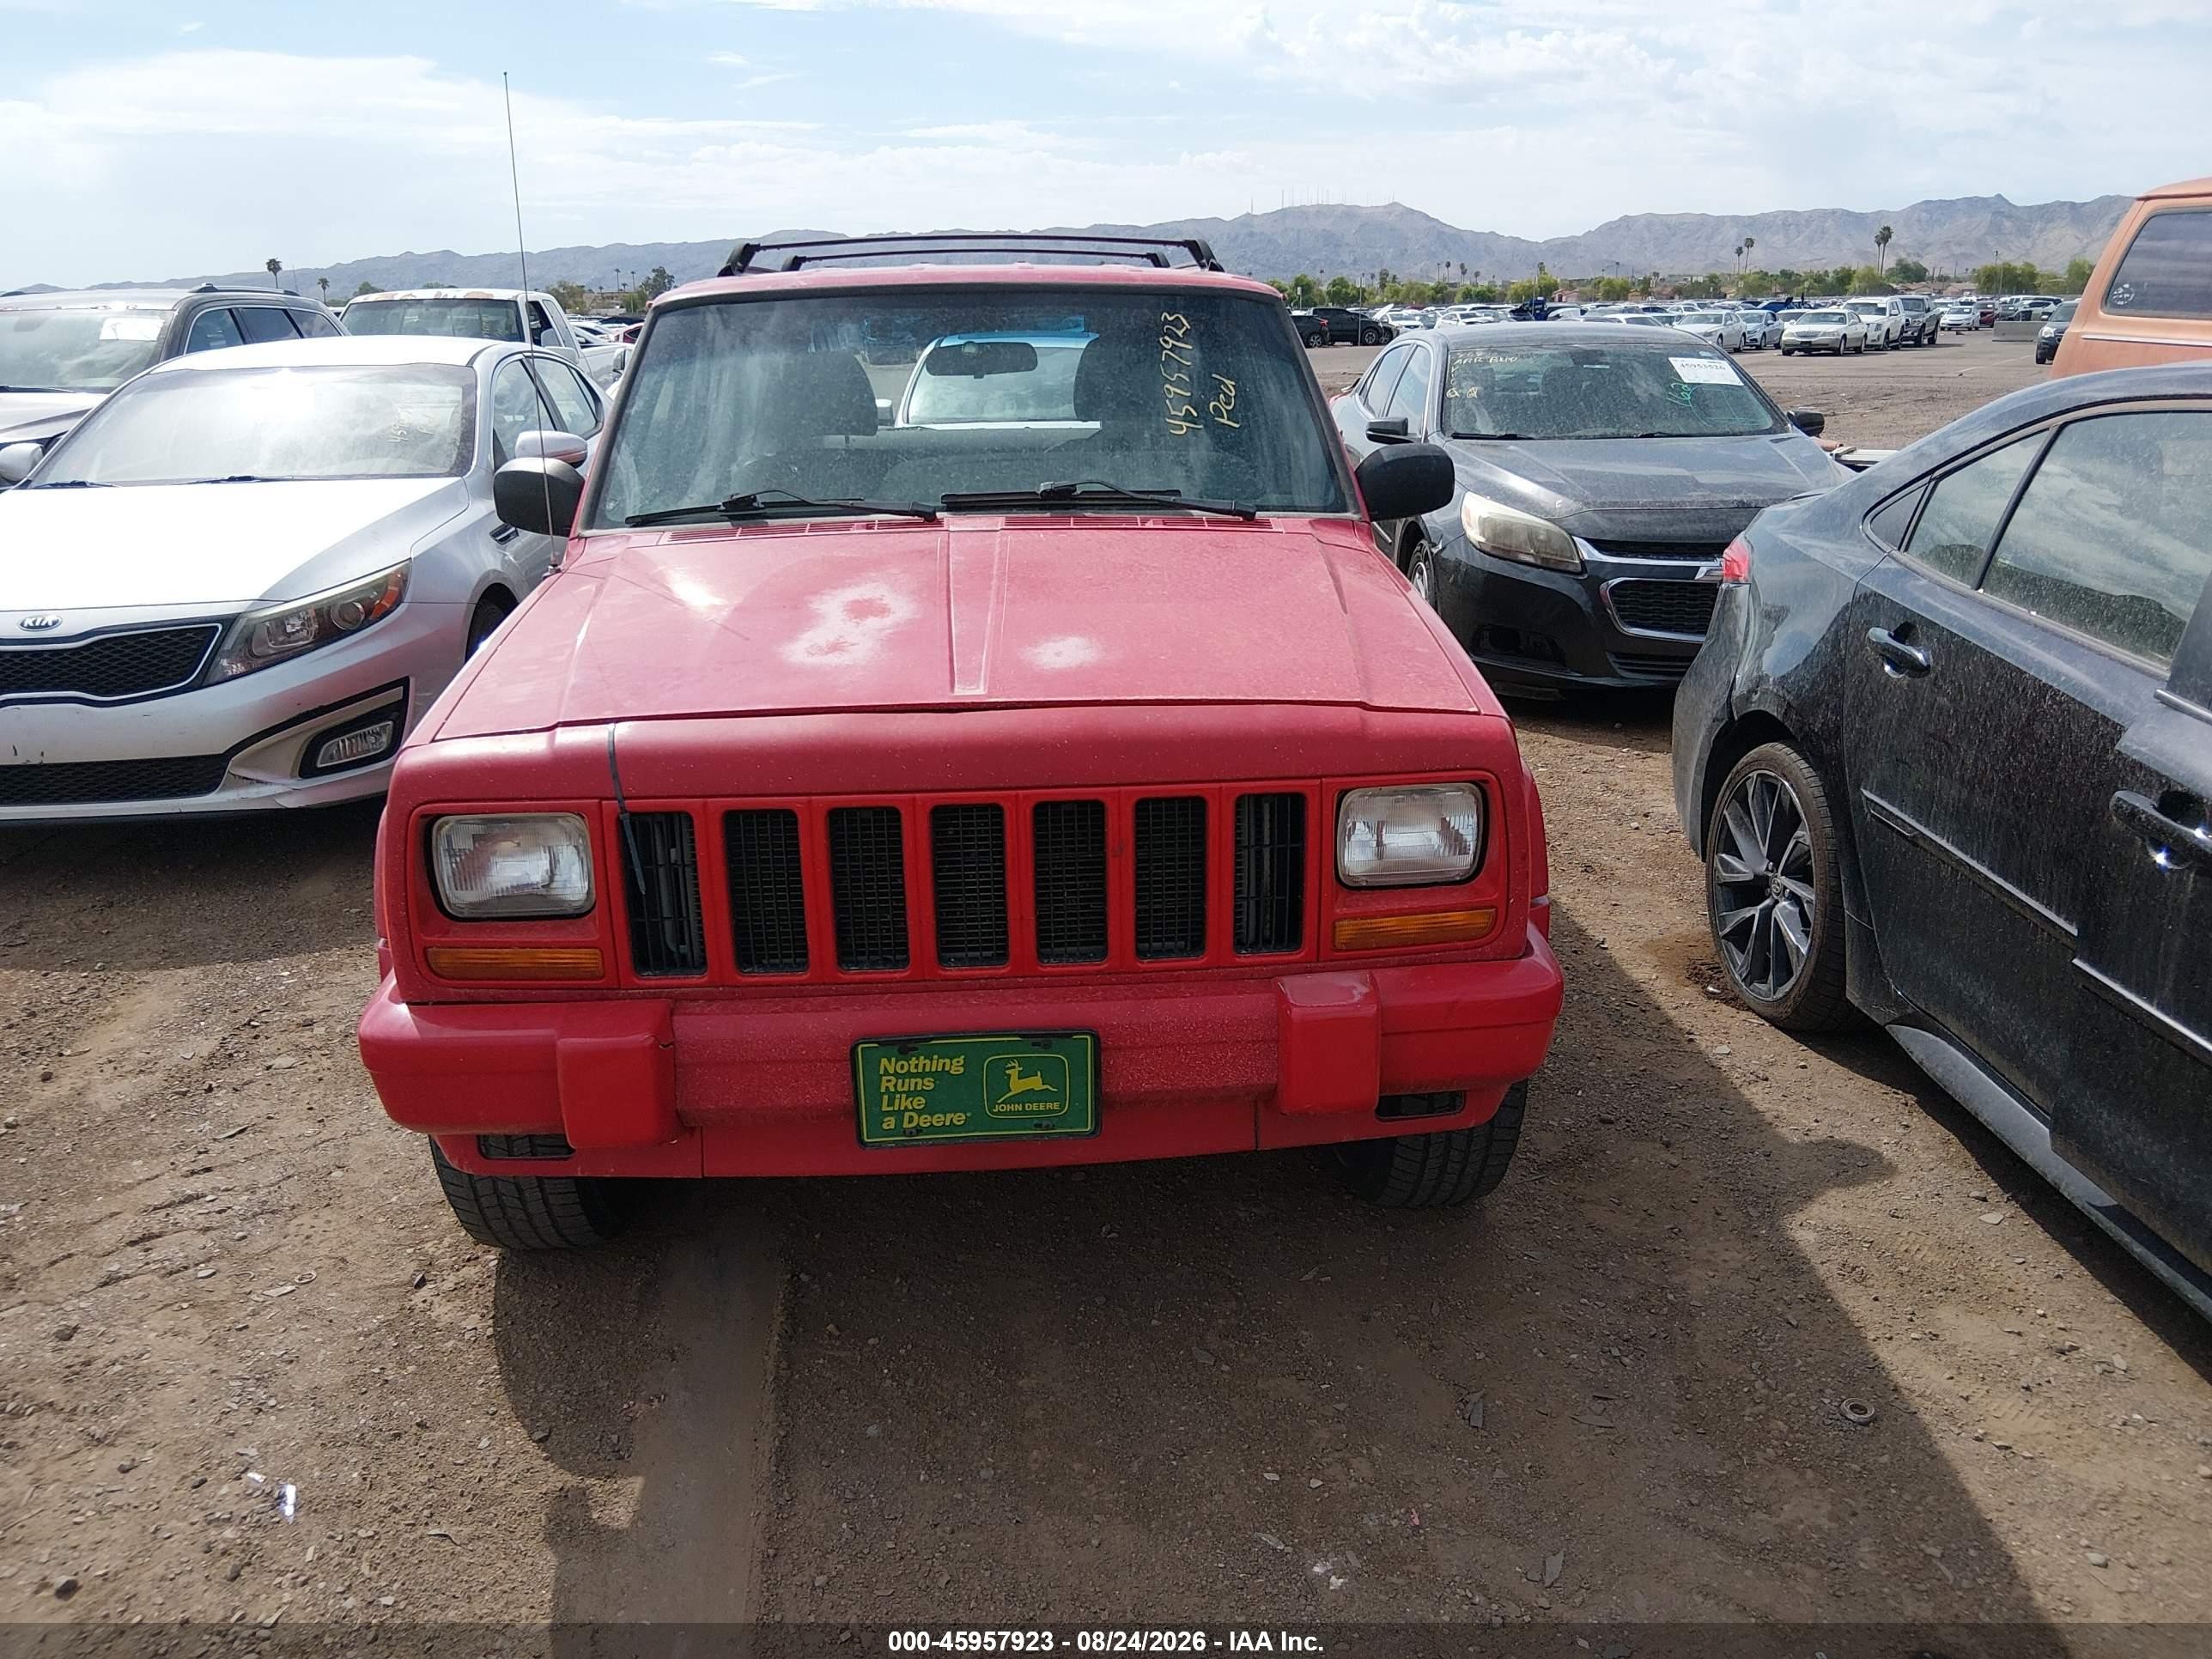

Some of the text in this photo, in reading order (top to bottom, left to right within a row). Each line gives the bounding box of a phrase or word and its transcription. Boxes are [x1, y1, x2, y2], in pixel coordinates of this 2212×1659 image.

[1159, 312, 1203, 434] 45957923
[23, 617, 54, 628] KIA
[879, 1054, 965, 1075] Nothing
[880, 1075, 935, 1092] Runs
[882, 1093, 926, 1111] Like
[993, 1102, 1060, 1113] JOHN DEERE
[882, 1111, 967, 1130] a Deere
